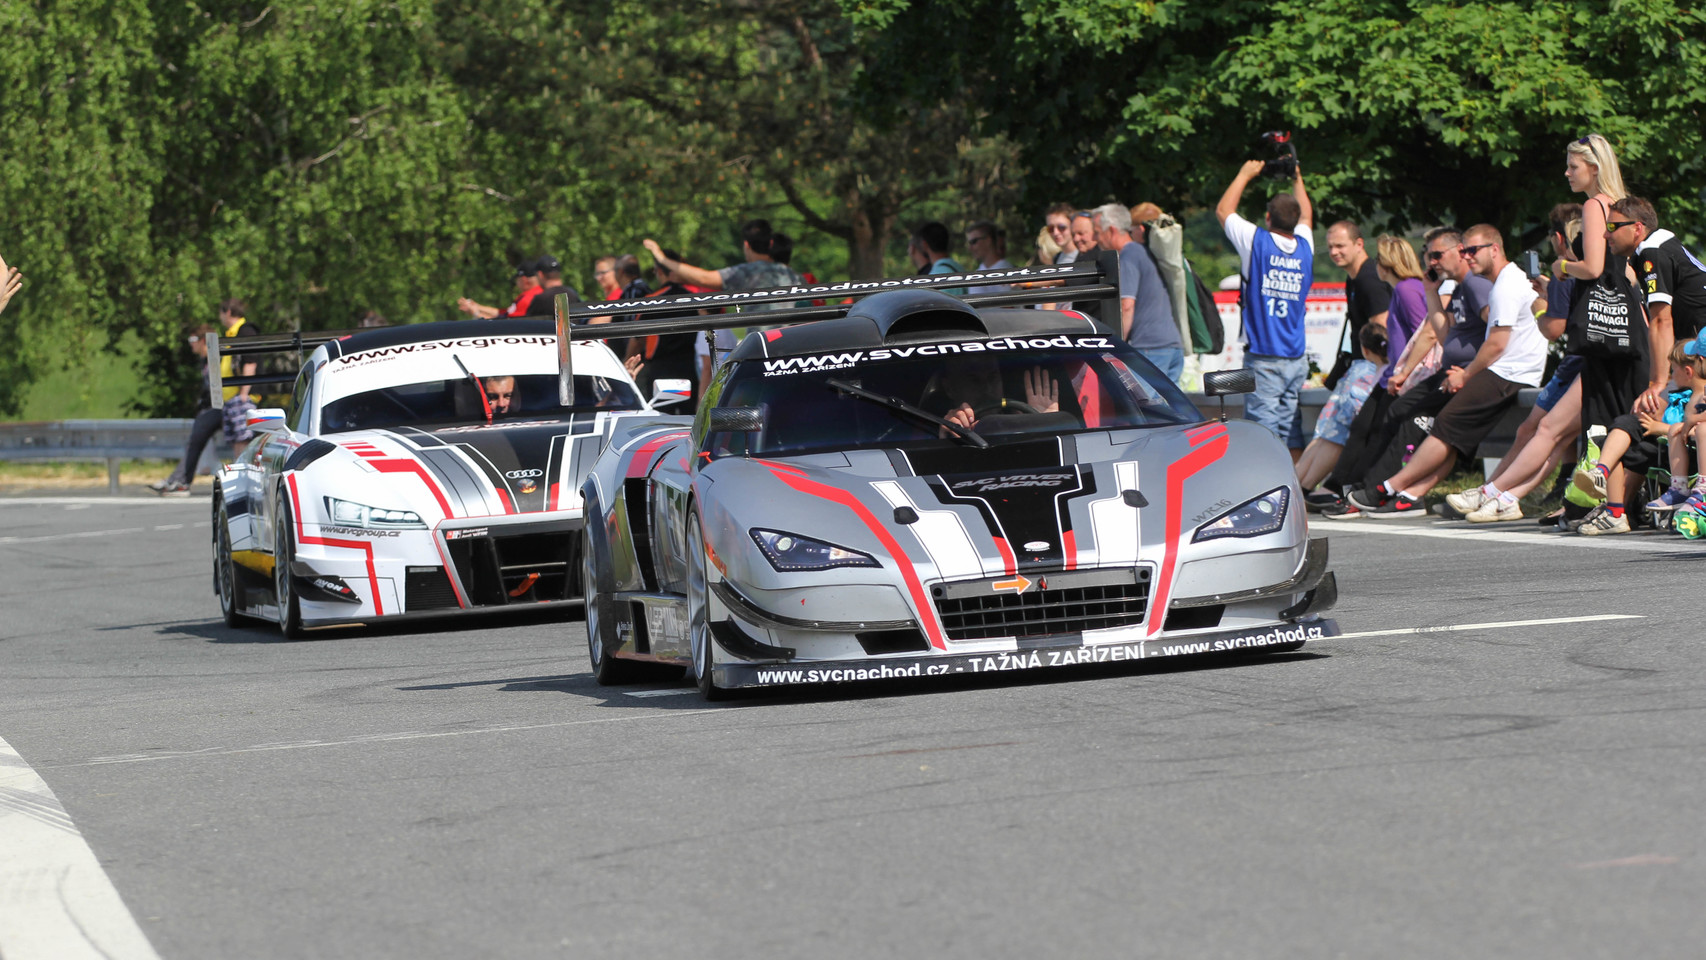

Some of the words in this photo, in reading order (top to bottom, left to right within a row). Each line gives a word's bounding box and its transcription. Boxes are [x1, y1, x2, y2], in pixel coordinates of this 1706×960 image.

[587, 265, 1075, 311] www.svcnachodmotorsport.cz
[1262, 273, 1301, 293] homo
[1266, 297, 1289, 319] 13
[1588, 301, 1628, 315] PATRIZIO
[1587, 311, 1629, 326] TRAVAGLI
[763, 335, 1115, 372] www.svcnachod.cz
[763, 367, 799, 377] TAŽNÁ
[801, 361, 856, 373] ZAŘÍZENÍ
[952, 477, 996, 489] SVC
[979, 480, 1062, 492] RACING
[320, 525, 401, 538] www.svcgroup.cz
[757, 662, 950, 684] www.svcnachod.cz
[968, 650, 1042, 673] TAŽNÁ
[1047, 641, 1146, 667] ZAŘÍZENÍ
[1162, 624, 1325, 656] www.svcnachod.cz
